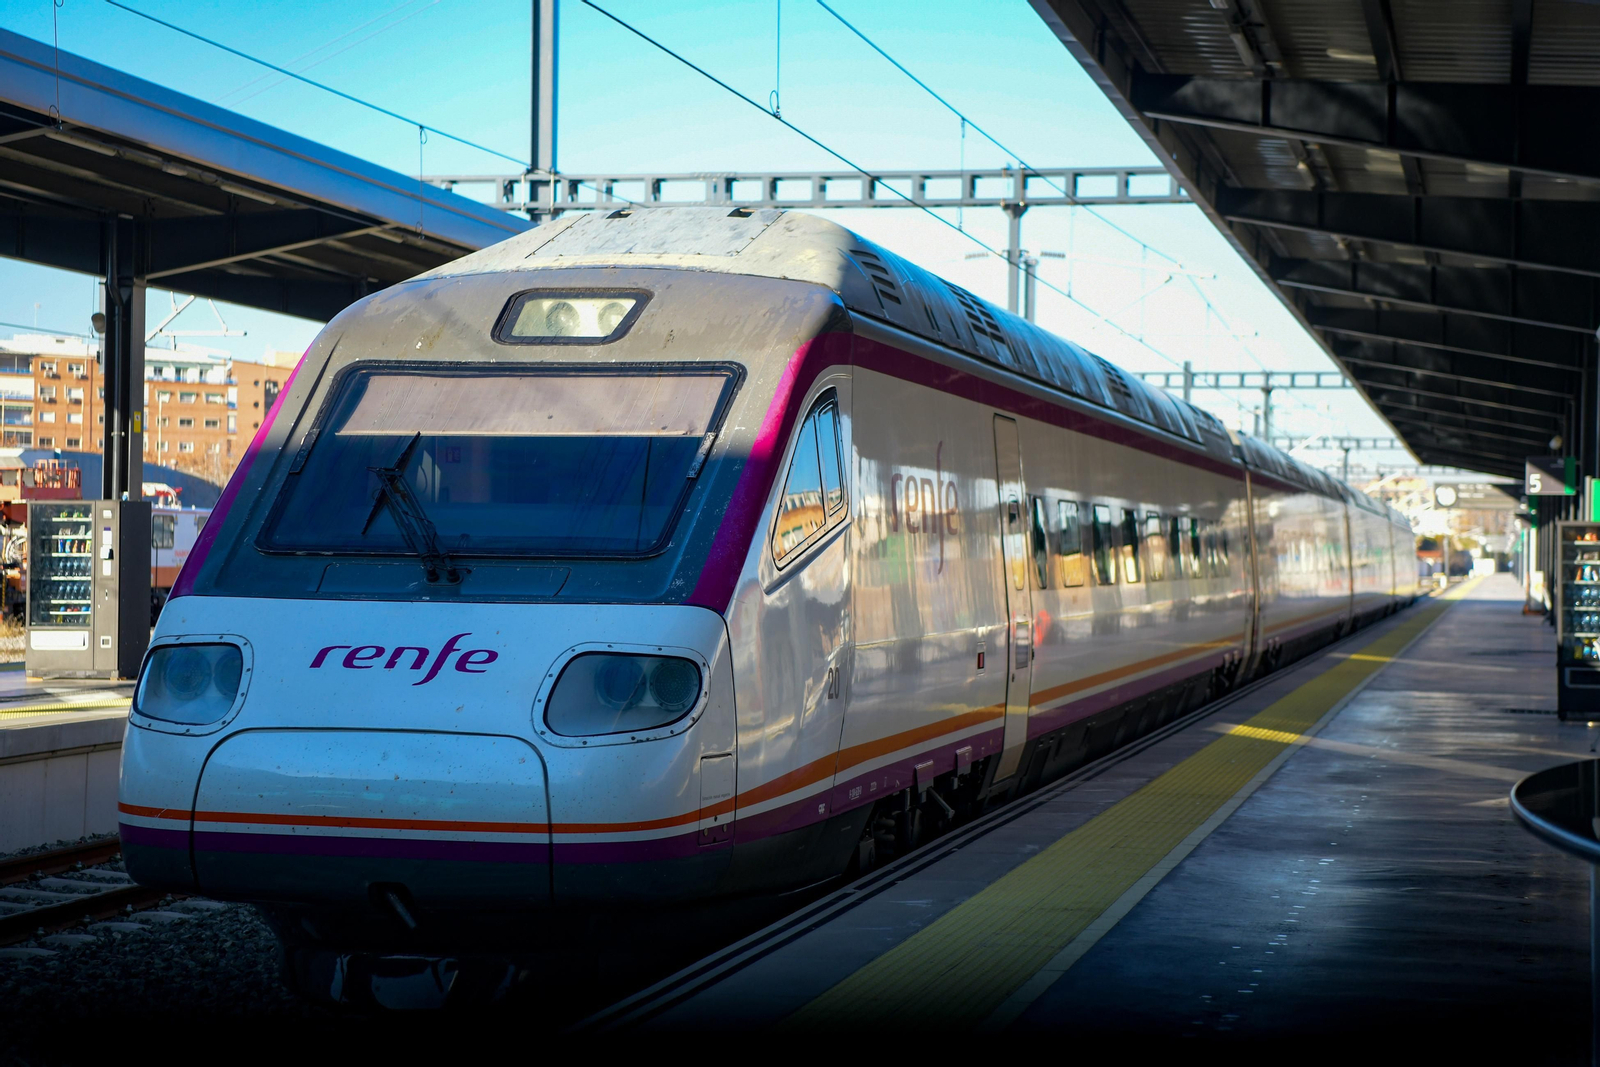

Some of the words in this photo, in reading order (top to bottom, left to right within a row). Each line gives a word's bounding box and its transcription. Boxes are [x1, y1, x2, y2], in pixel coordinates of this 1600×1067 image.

[1529, 473, 1542, 494] 5
[891, 440, 958, 575] renfe
[309, 632, 499, 687] renfe
[827, 667, 840, 700] 20
